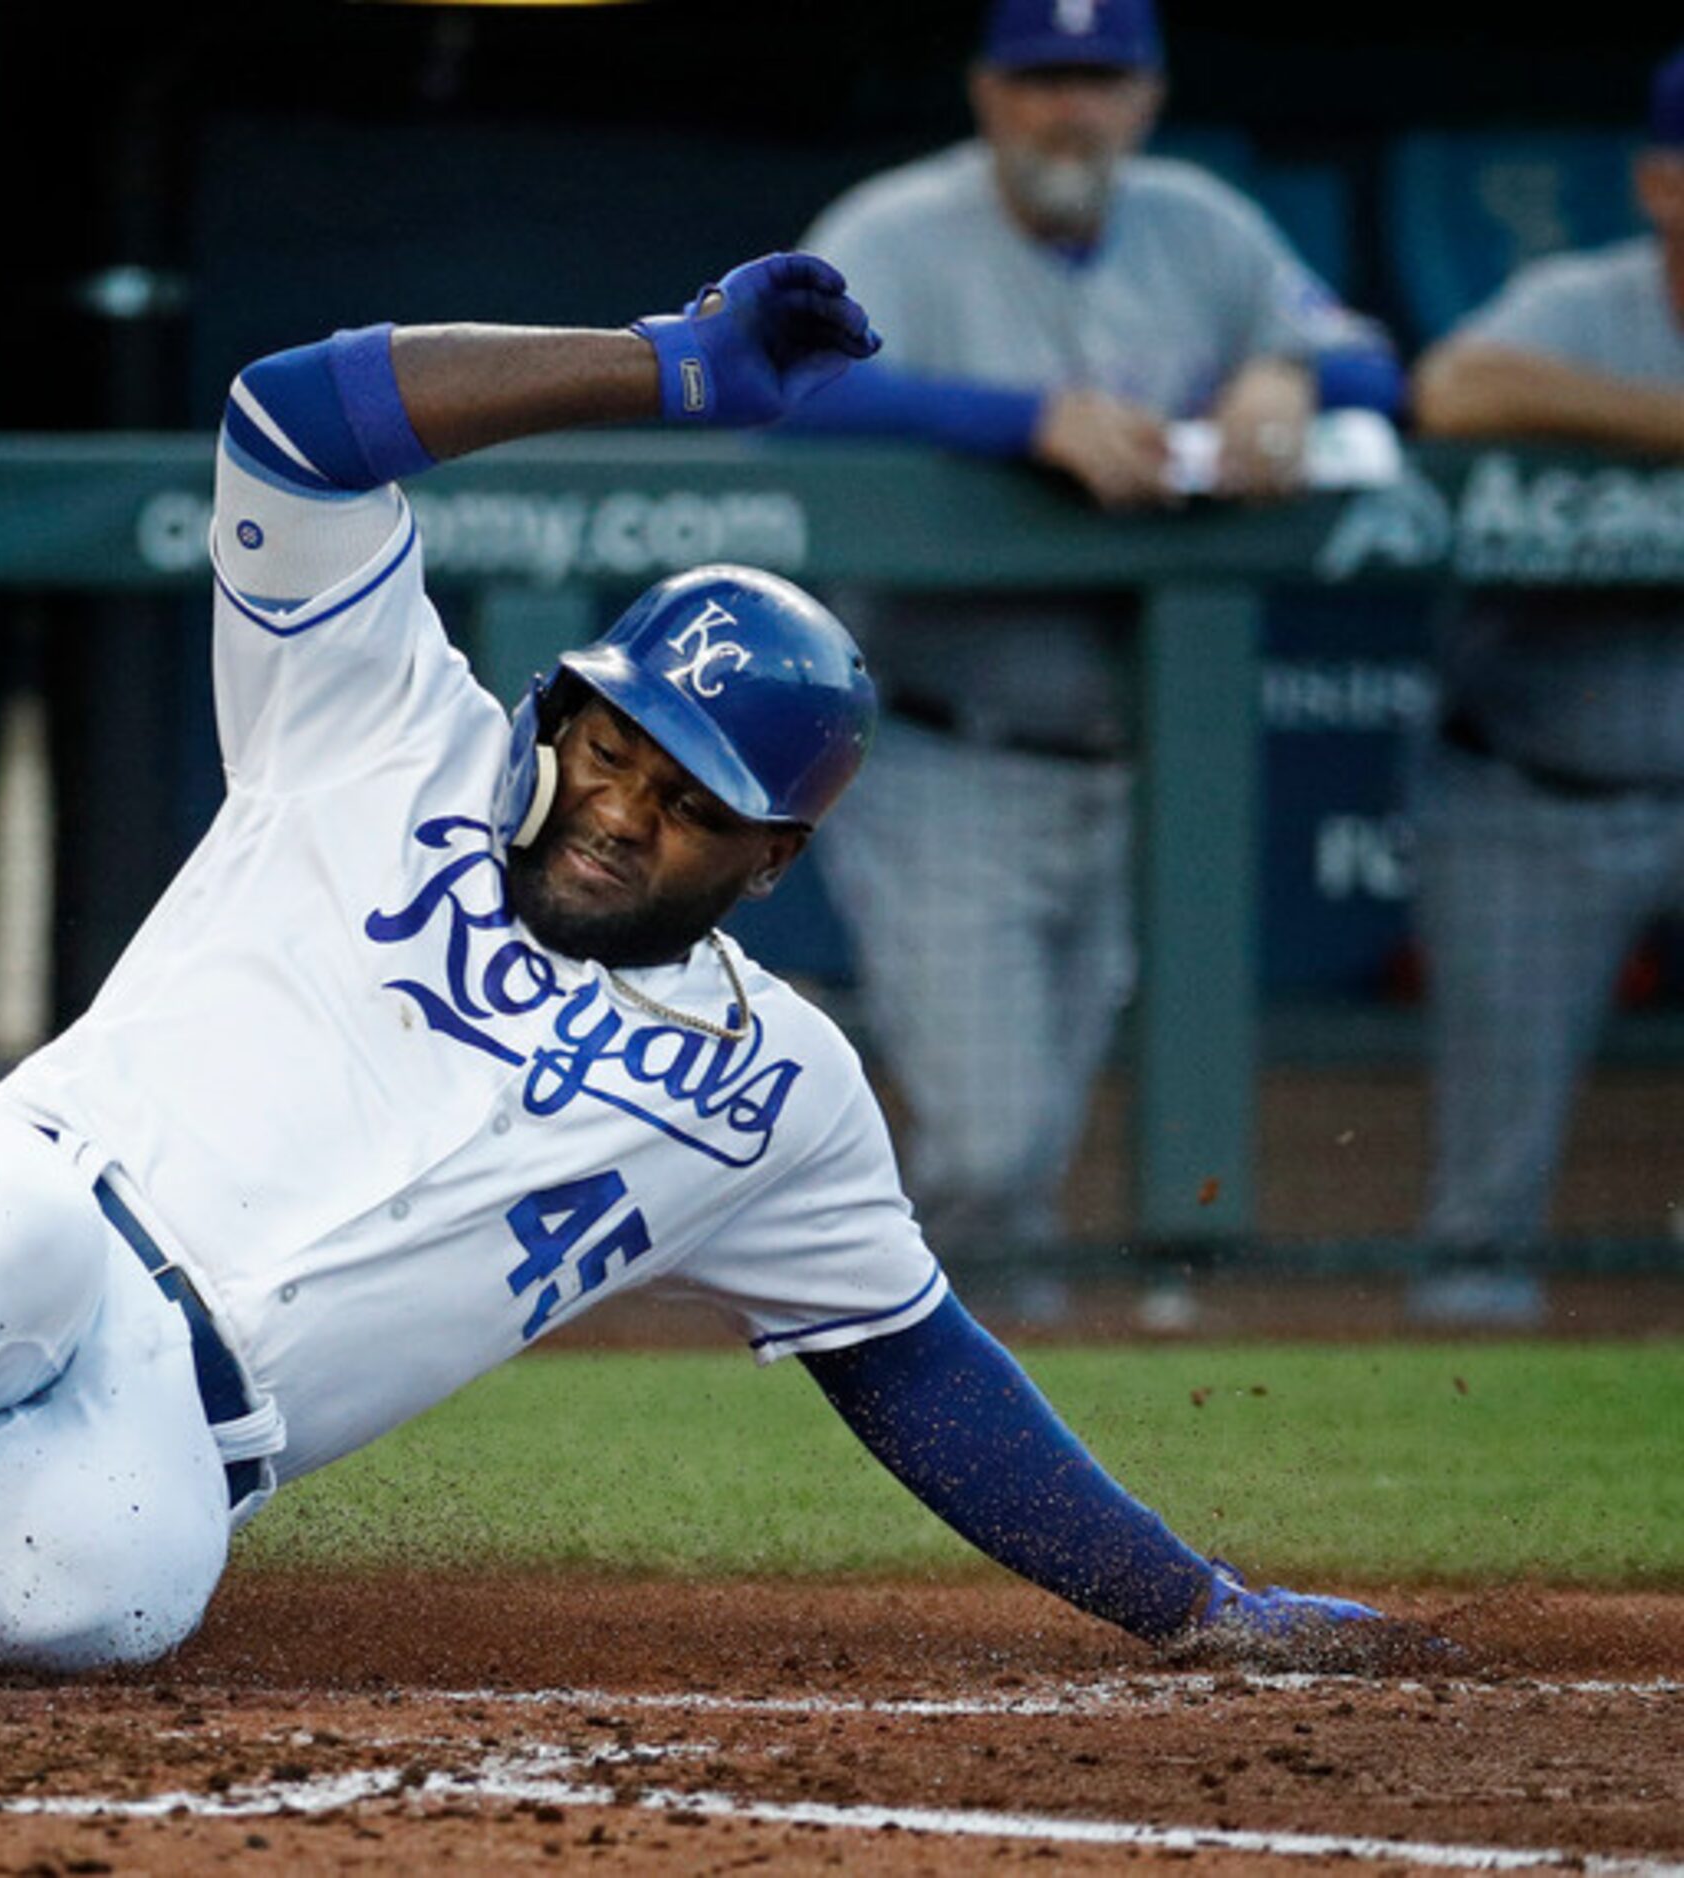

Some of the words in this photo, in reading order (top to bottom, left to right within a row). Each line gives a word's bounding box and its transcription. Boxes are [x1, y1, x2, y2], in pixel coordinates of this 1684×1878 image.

[662, 598, 753, 699] KC
[364, 814, 804, 1168] Royals
[505, 1169, 653, 1341] 45
